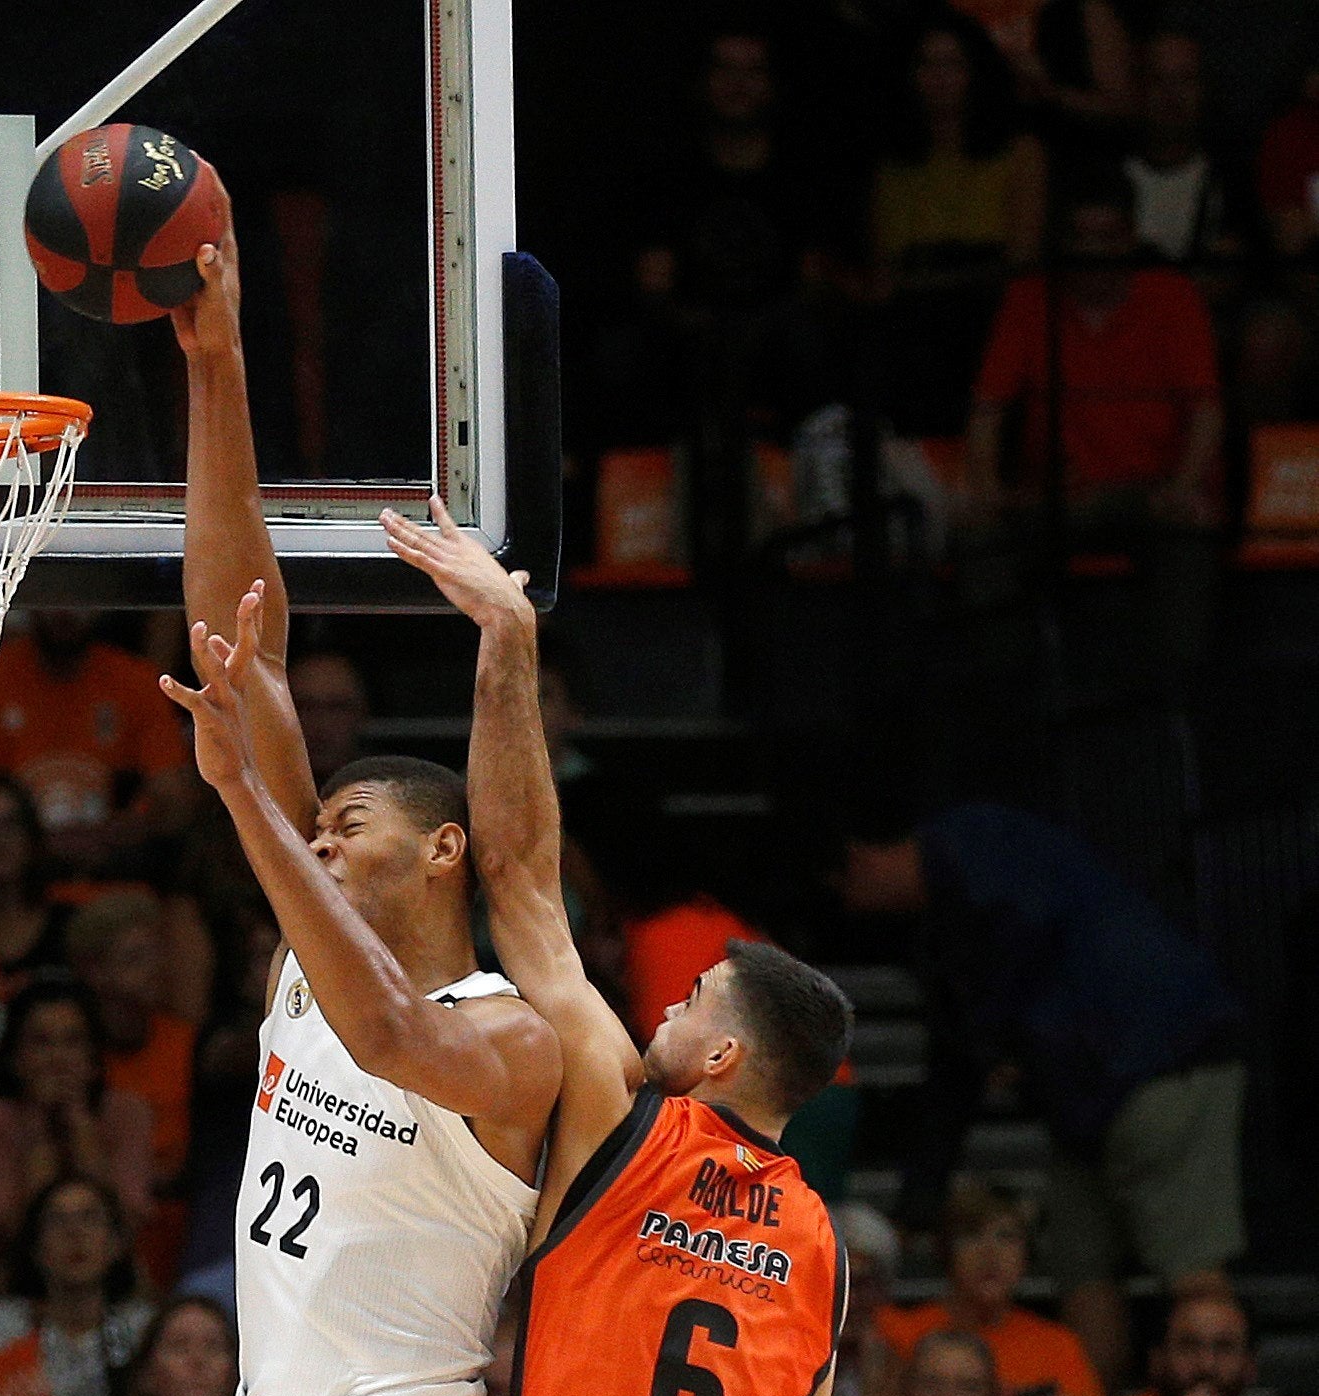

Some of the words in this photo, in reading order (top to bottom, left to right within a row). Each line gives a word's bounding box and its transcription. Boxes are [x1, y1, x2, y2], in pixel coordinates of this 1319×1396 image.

[275, 1097, 359, 1157] Europea
[285, 1068, 419, 1147] Universidad
[249, 1161, 321, 1260] 22
[637, 1210, 792, 1285] PAMESA
